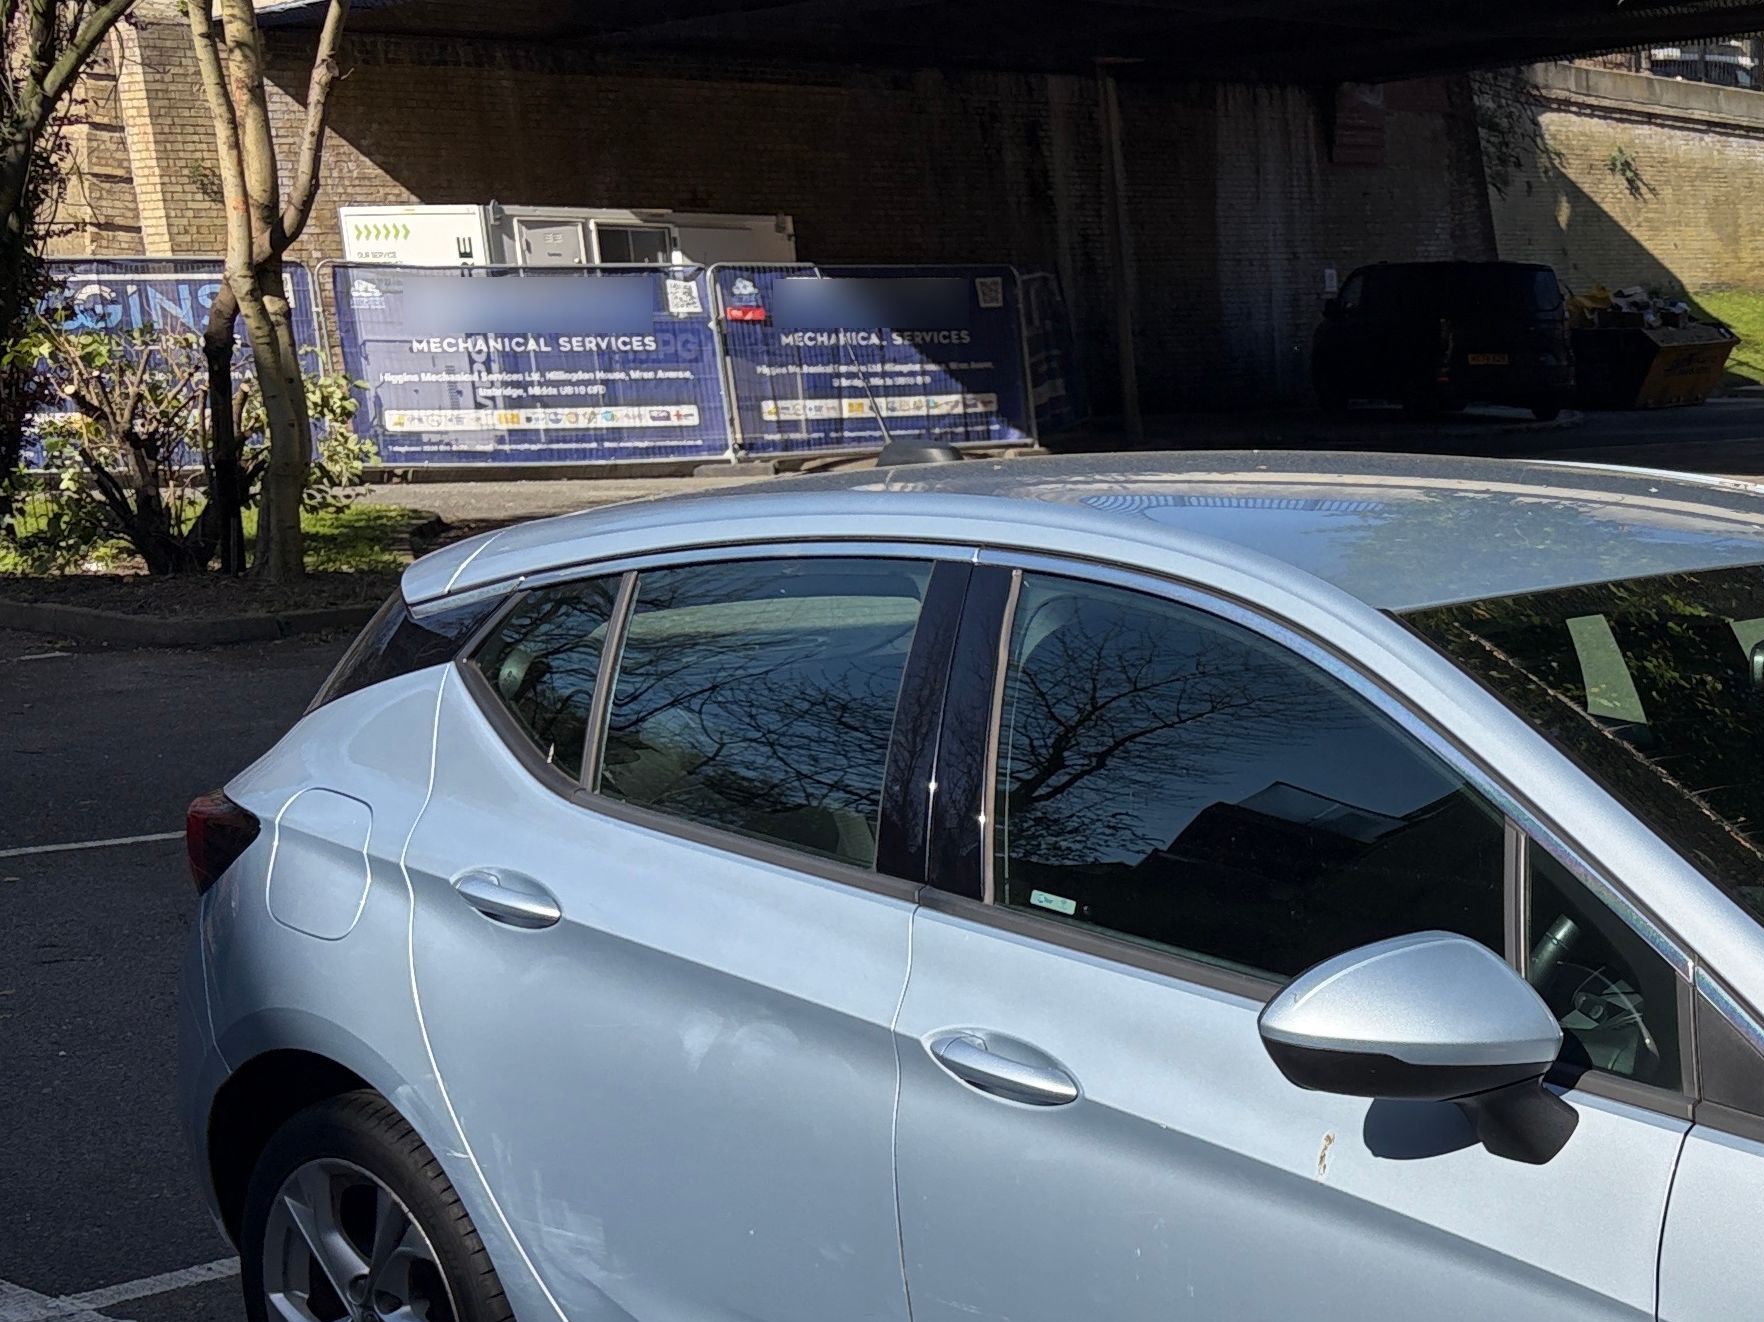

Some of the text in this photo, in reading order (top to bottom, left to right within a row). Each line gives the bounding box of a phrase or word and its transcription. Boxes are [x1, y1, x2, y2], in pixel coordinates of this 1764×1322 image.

[412, 335, 657, 353] MECHANICAL SERVICES
[892, 330, 972, 346] SERVICES
